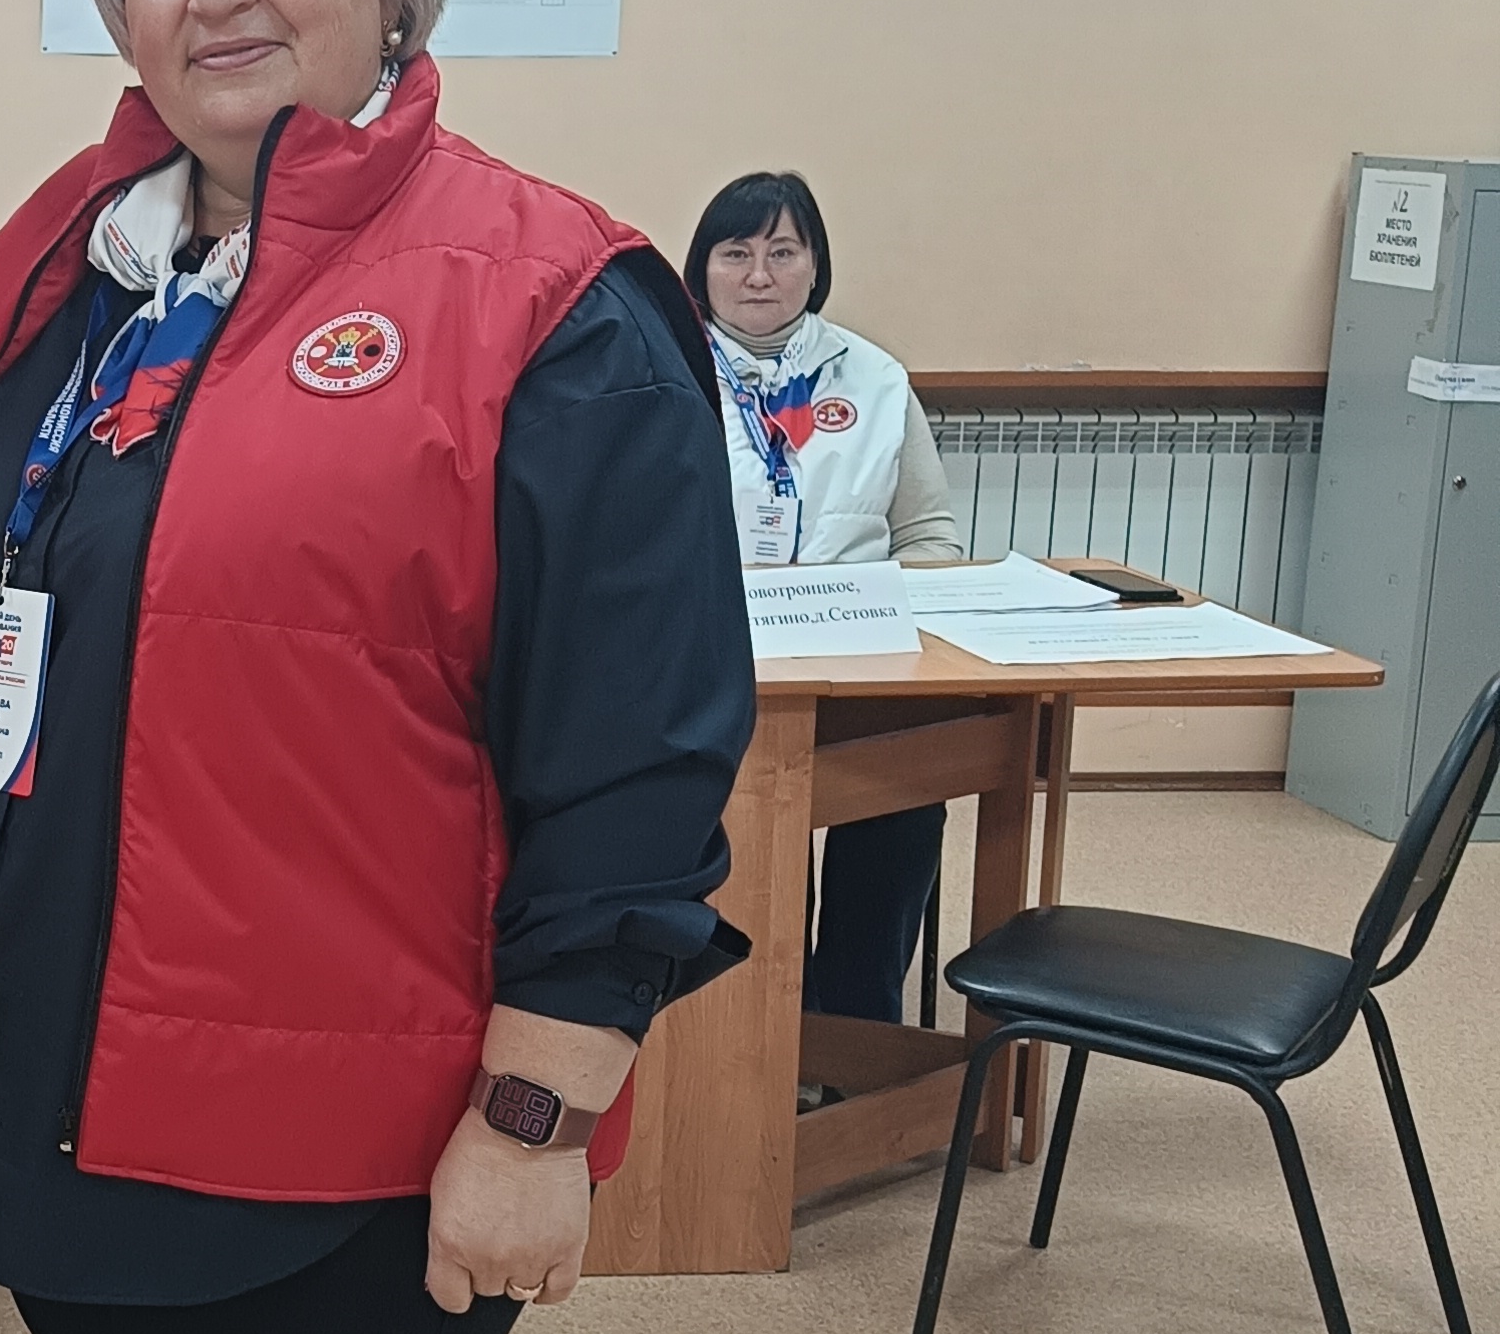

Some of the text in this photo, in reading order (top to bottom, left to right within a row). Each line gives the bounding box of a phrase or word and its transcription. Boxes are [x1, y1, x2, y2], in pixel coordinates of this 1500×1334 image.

[1385, 217, 1412, 232] МЕСТО
[1376, 232, 1418, 249] ХРАНЕНИЯ
[1369, 249, 1421, 267] БЮЛЛЕТЕНЕЙ
[748, 581, 861, 601] овотроицкое,
[751, 606, 898, 627] тягино,д.Сетовка
[1, 638, 14, 651] 20
